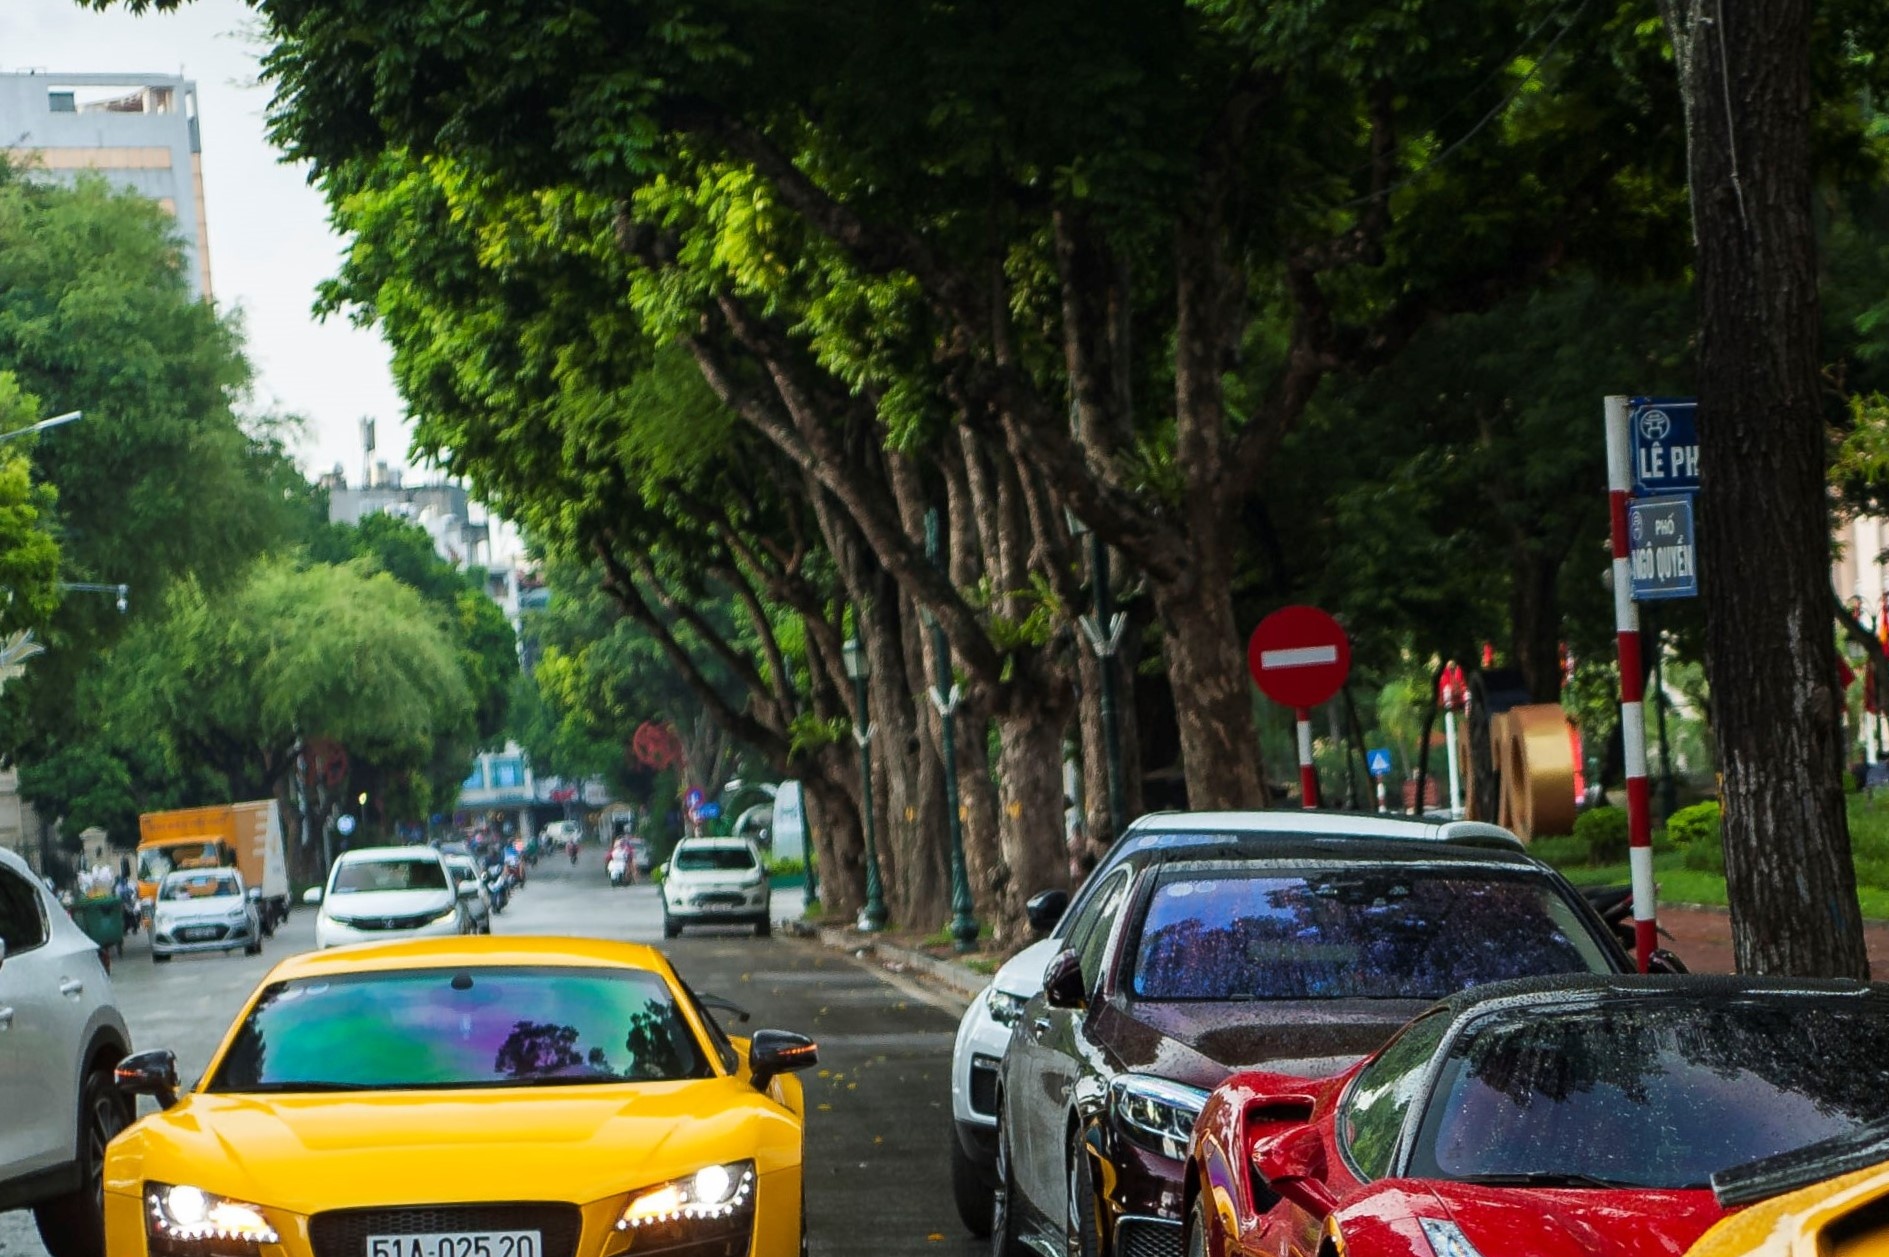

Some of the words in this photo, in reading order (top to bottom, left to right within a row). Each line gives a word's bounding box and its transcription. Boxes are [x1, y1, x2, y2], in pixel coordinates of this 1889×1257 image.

[1640, 441, 1665, 479] LÊ
[1655, 512, 1675, 535] PHỐ
[1631, 541, 1655, 580] NGÔ
